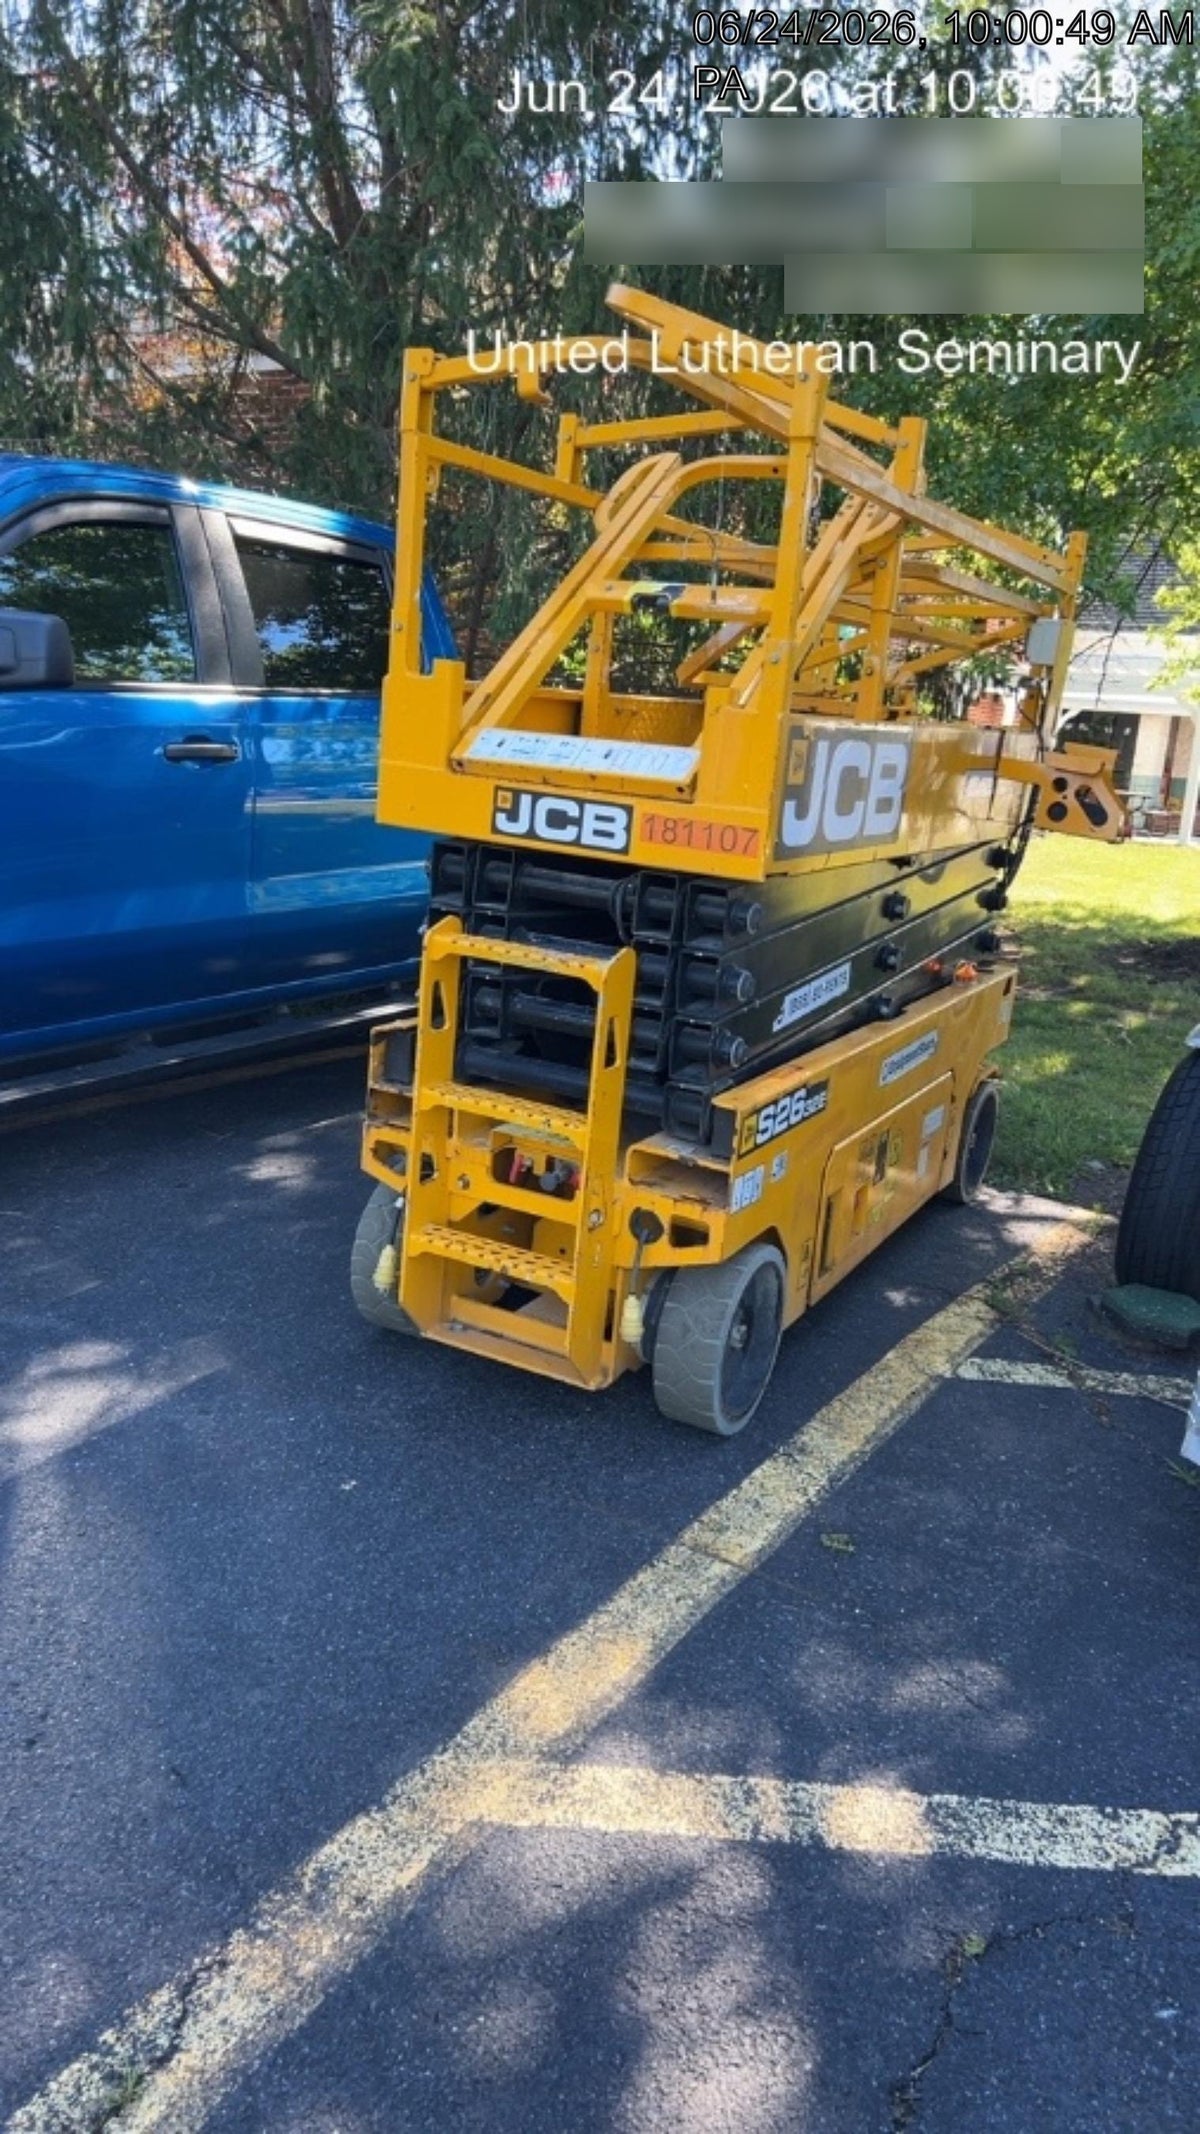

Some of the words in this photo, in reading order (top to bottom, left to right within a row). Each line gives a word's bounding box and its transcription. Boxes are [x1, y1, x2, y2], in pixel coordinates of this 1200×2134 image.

[494, 790, 629, 851] JCB
[782, 738, 910, 849] JCB
[644, 813, 760, 856] 181107
